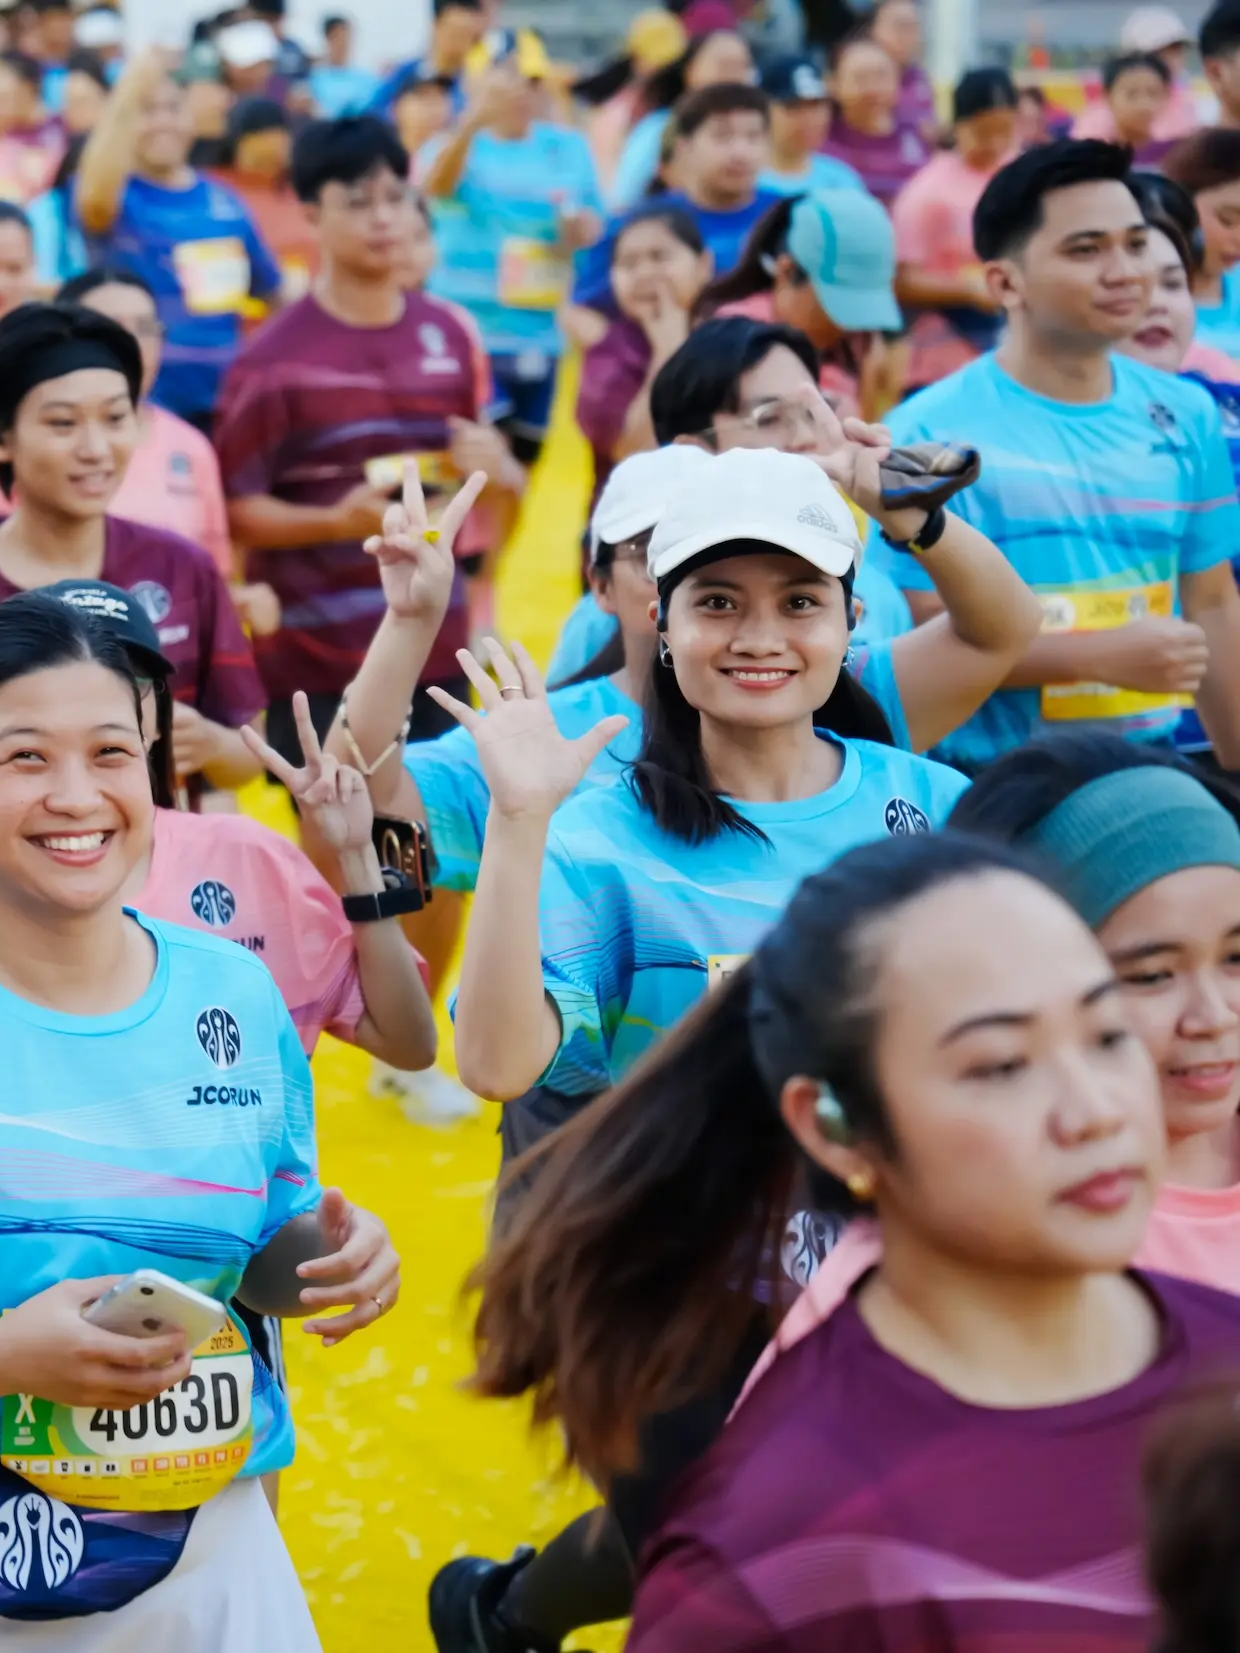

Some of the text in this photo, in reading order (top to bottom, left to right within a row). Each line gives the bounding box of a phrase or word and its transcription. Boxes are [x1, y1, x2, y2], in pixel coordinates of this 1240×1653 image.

[797, 513, 838, 533] adidas
[187, 1085, 262, 1107] JCORUN
[210, 1335, 234, 1350] 2025
